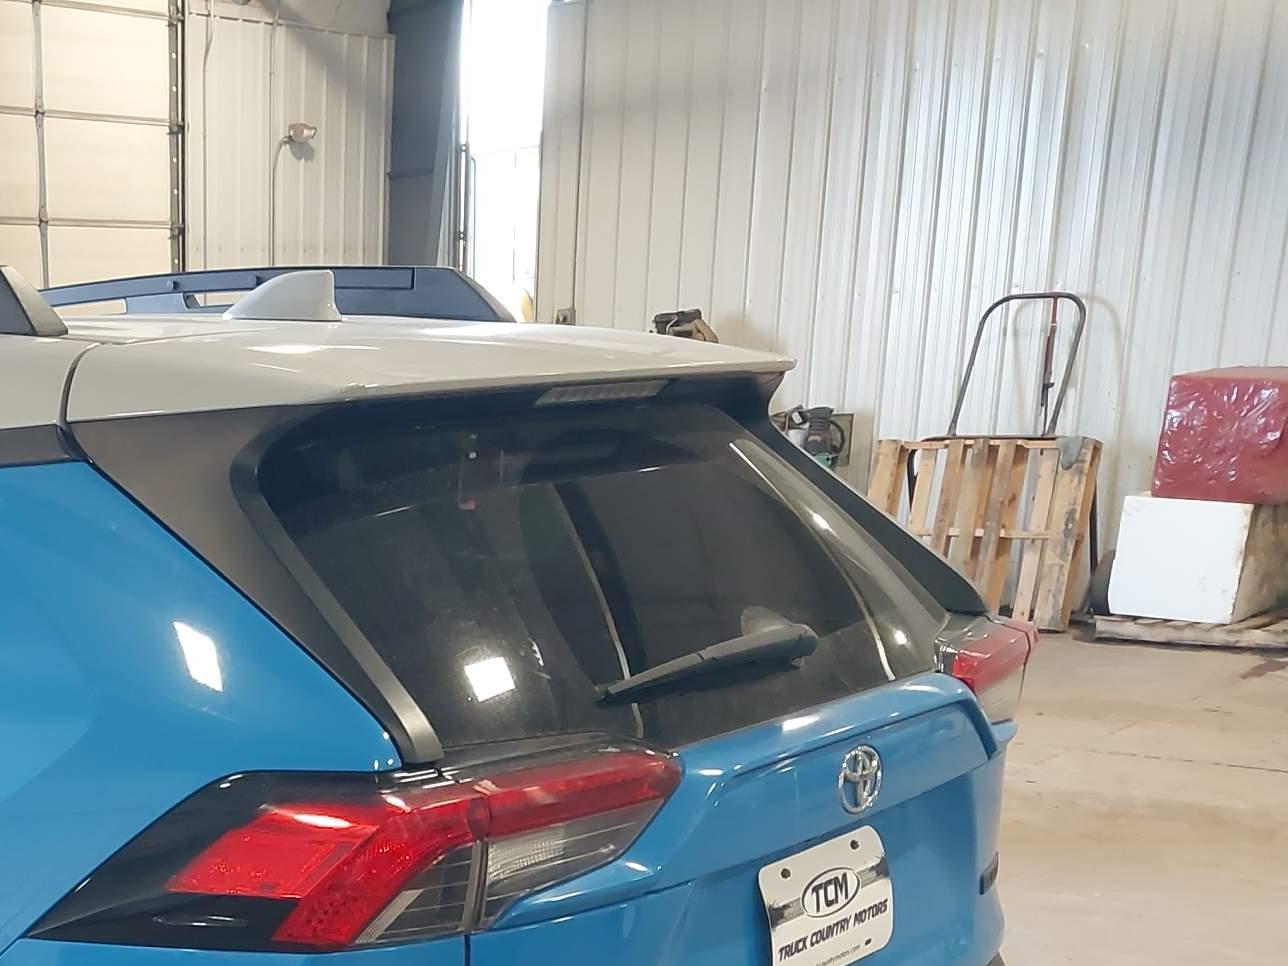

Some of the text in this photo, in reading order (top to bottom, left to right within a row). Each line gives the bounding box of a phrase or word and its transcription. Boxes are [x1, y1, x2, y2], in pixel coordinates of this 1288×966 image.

[811, 871, 850, 913] TCM
[778, 898, 889, 963] TRUCK COUNTRY MOTORS
